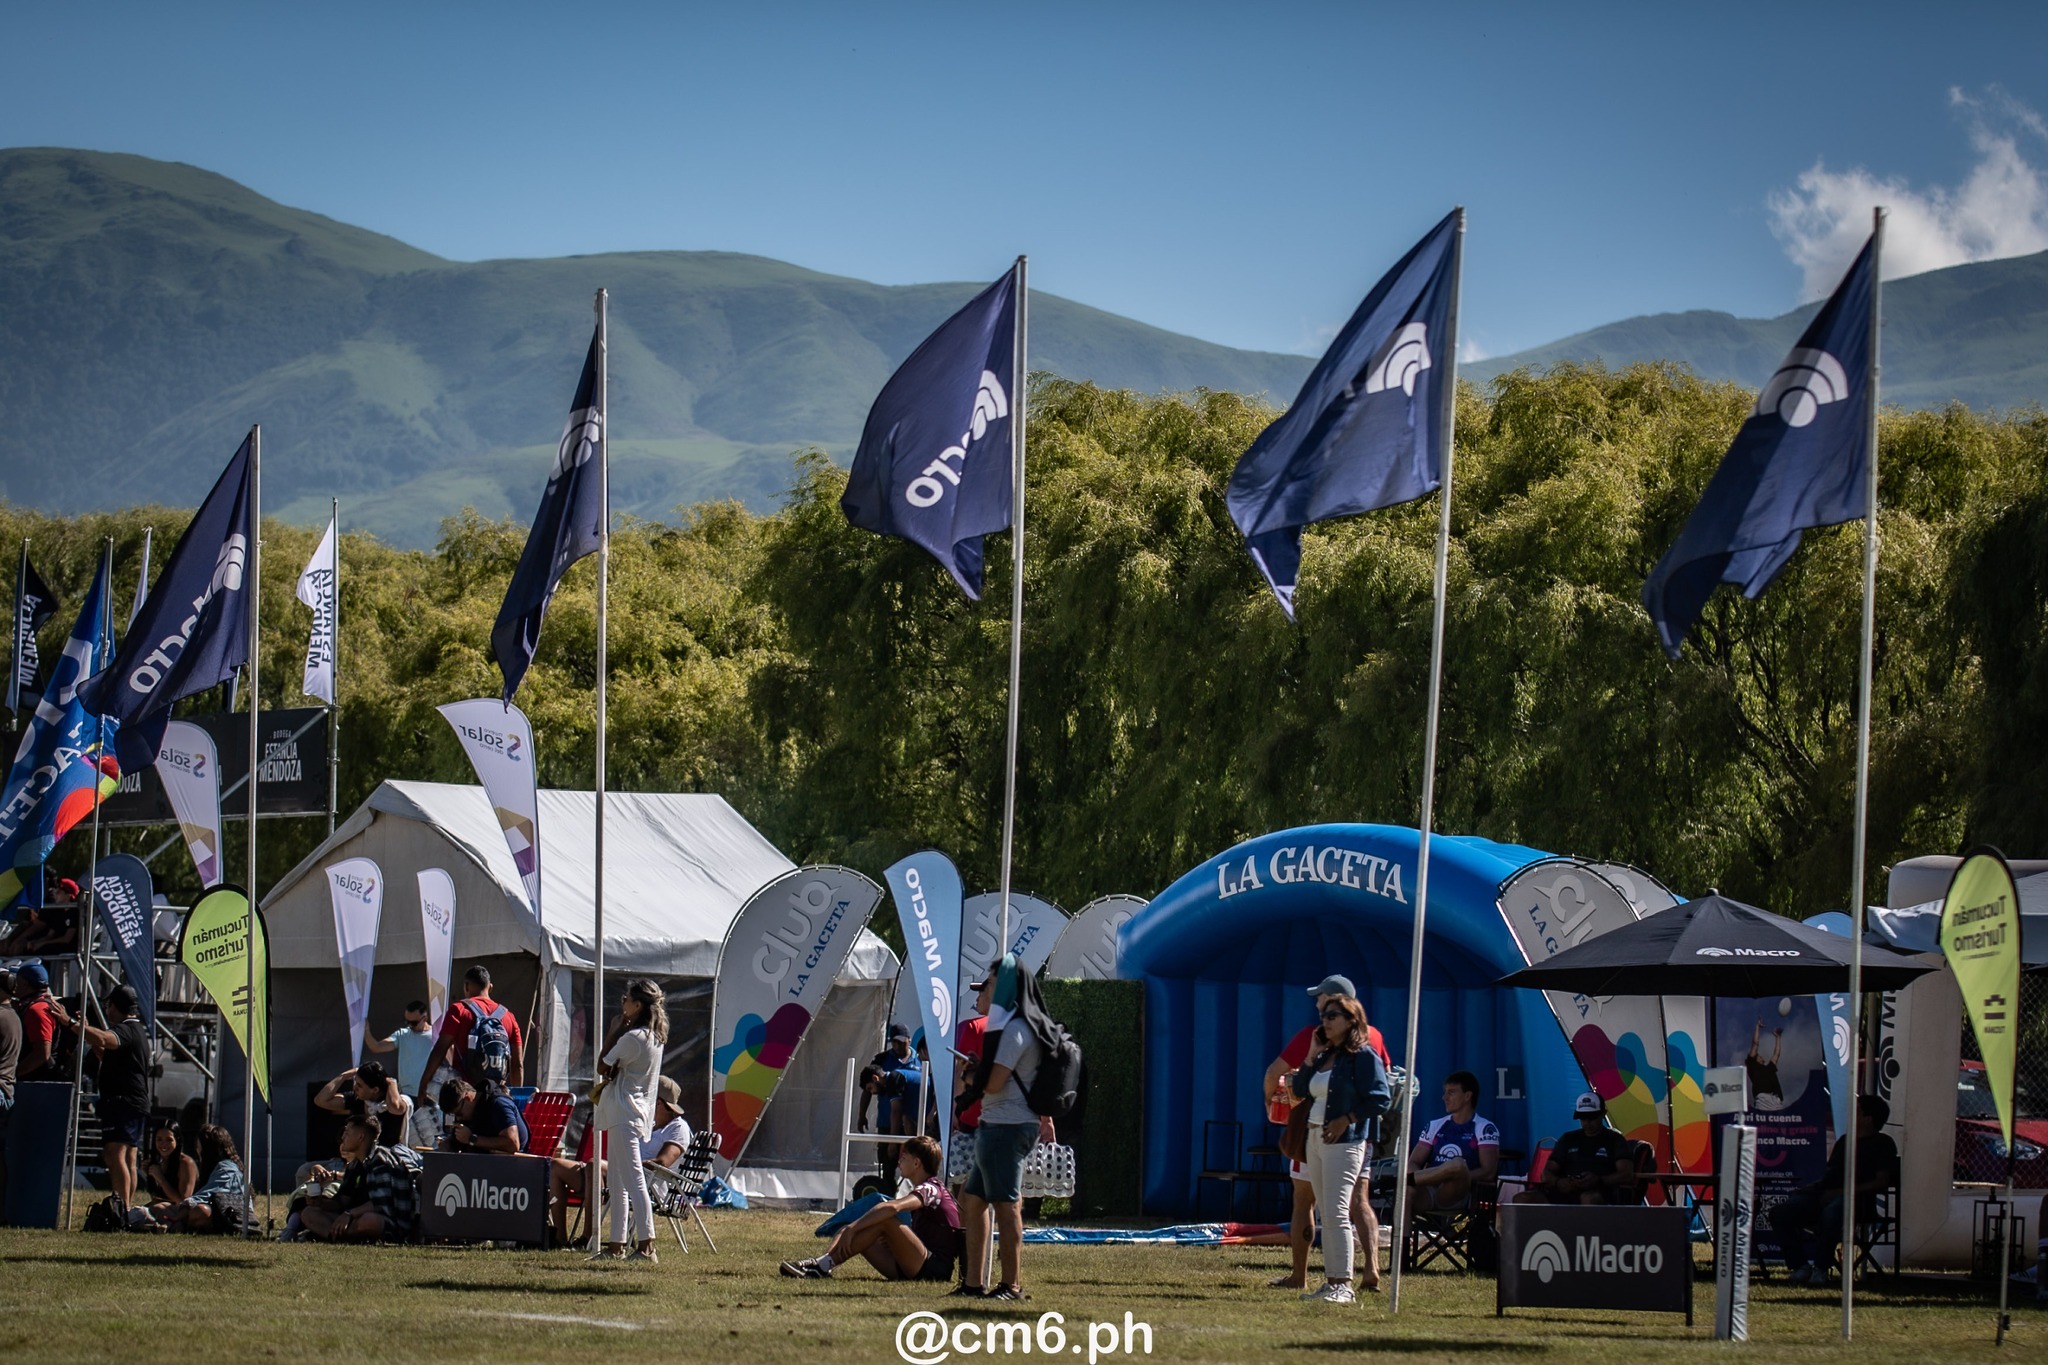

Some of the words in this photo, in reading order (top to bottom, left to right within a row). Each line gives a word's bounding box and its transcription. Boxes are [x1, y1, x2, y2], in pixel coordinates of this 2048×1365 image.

[258, 759, 302, 782] MENDOZA
[1217, 855, 1264, 900] LA
[1269, 845, 1408, 905] GACETA
[1528, 903, 1547, 937] LA
[789, 975, 810, 998] LA
[805, 900, 851, 969] GACETA
[1734, 948, 1800, 957] Macro
[1756, 1113, 1766, 1122] tu
[1768, 1114, 1802, 1123] cuenta
[1756, 1137, 1774, 1145] nco
[1776, 1137, 1810, 1145] Macro.
[471, 1178, 529, 1212] Macro
[1575, 1235, 1664, 1274] Macro
[1720, 1232, 1731, 1278] Macro
